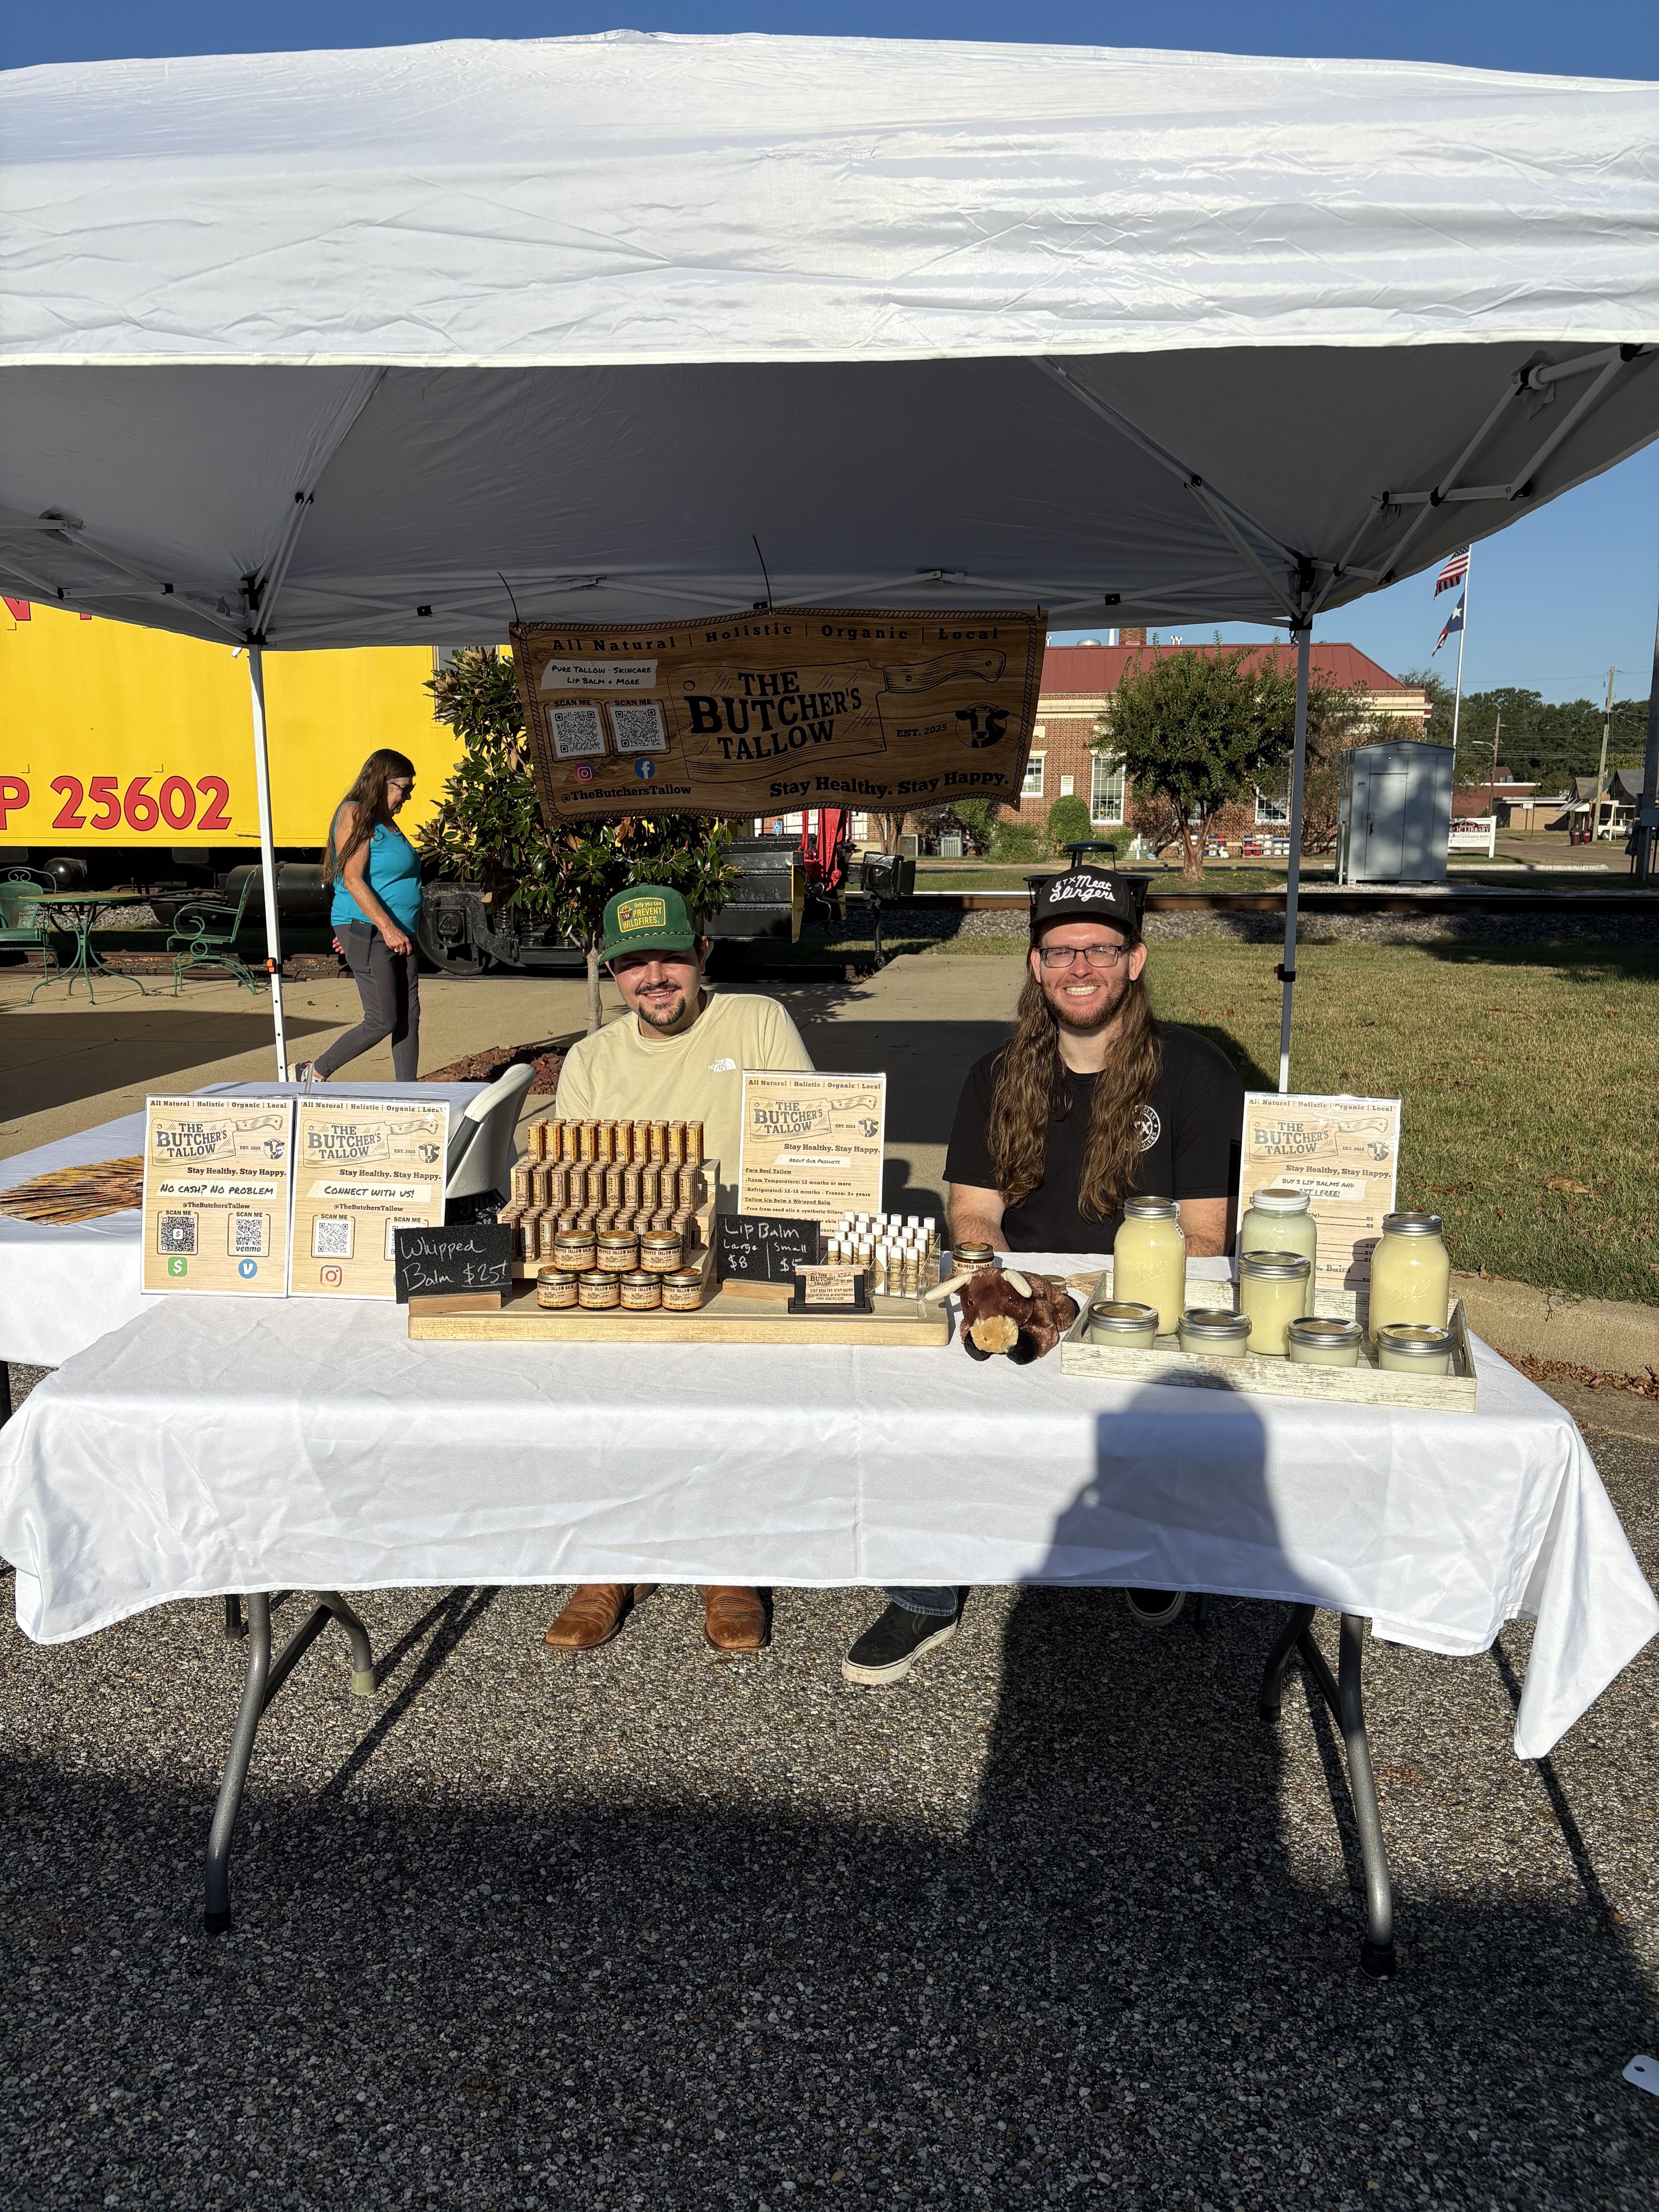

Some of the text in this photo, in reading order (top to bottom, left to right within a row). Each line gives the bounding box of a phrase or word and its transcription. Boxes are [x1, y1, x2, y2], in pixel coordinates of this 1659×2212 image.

[553, 623, 998, 651] All Natural Holistic Organic Local
[738, 671, 800, 696] THE
[684, 687, 862, 734] BUTCHER'S
[896, 723, 948, 738] EST. 2025
[717, 720, 835, 760] TALLOW
[769, 771, 1008, 799] Stay Healthy. Stay Happy.
[561, 785, 692, 803] @TheButchersTallow
[50, 776, 232, 831] 25602
[1055, 875, 1112, 890] ETX Meat
[1049, 885, 1116, 902] Slingers
[633, 907, 662, 917] PREVENT
[623, 916, 659, 929] WILDFIRES.
[776, 1101, 800, 1111] THE
[754, 1108, 823, 1124] BUTCHER'S
[179, 1123, 203, 1133] THE
[331, 1125, 357, 1135] THE
[764, 1121, 812, 1134] TALLOW
[1278, 1122, 1304, 1132] THE
[156, 1130, 227, 1147] BUTCHER'S
[308, 1133, 381, 1149] BUTCHER'S
[1254, 1128, 1329, 1145] BUTCHER'S
[167, 1144, 216, 1157] TALLOW
[319, 1146, 369, 1159] TALLOW
[802, 1144, 833, 1153] Healthy.
[835, 1146, 852, 1154] Stay
[854, 1146, 881, 1154] Happy.
[1265, 1143, 1317, 1154] TALLOW
[187, 1167, 204, 1175] Stay
[206, 1168, 238, 1176] Healthy.
[359, 1170, 392, 1178] Healthy.
[414, 1172, 441, 1180] Happy.
[1286, 1164, 1391, 1178] Stay Stay Happy.
[160, 1184, 175, 1192] NO
[178, 1185, 207, 1194] CASH?
[210, 1185, 224, 1194] NO
[324, 1186, 414, 1198] CONNECT WITH US!
[334, 1204, 404, 1212] @TheButchersTallow
[725, 1218, 800, 1240] Lip Balm
[400, 1237, 487, 1262] Whipped
[724, 1239, 807, 1254] Large Small
[728, 1254, 748, 1271] $8
[402, 1263, 454, 1291] Balm
